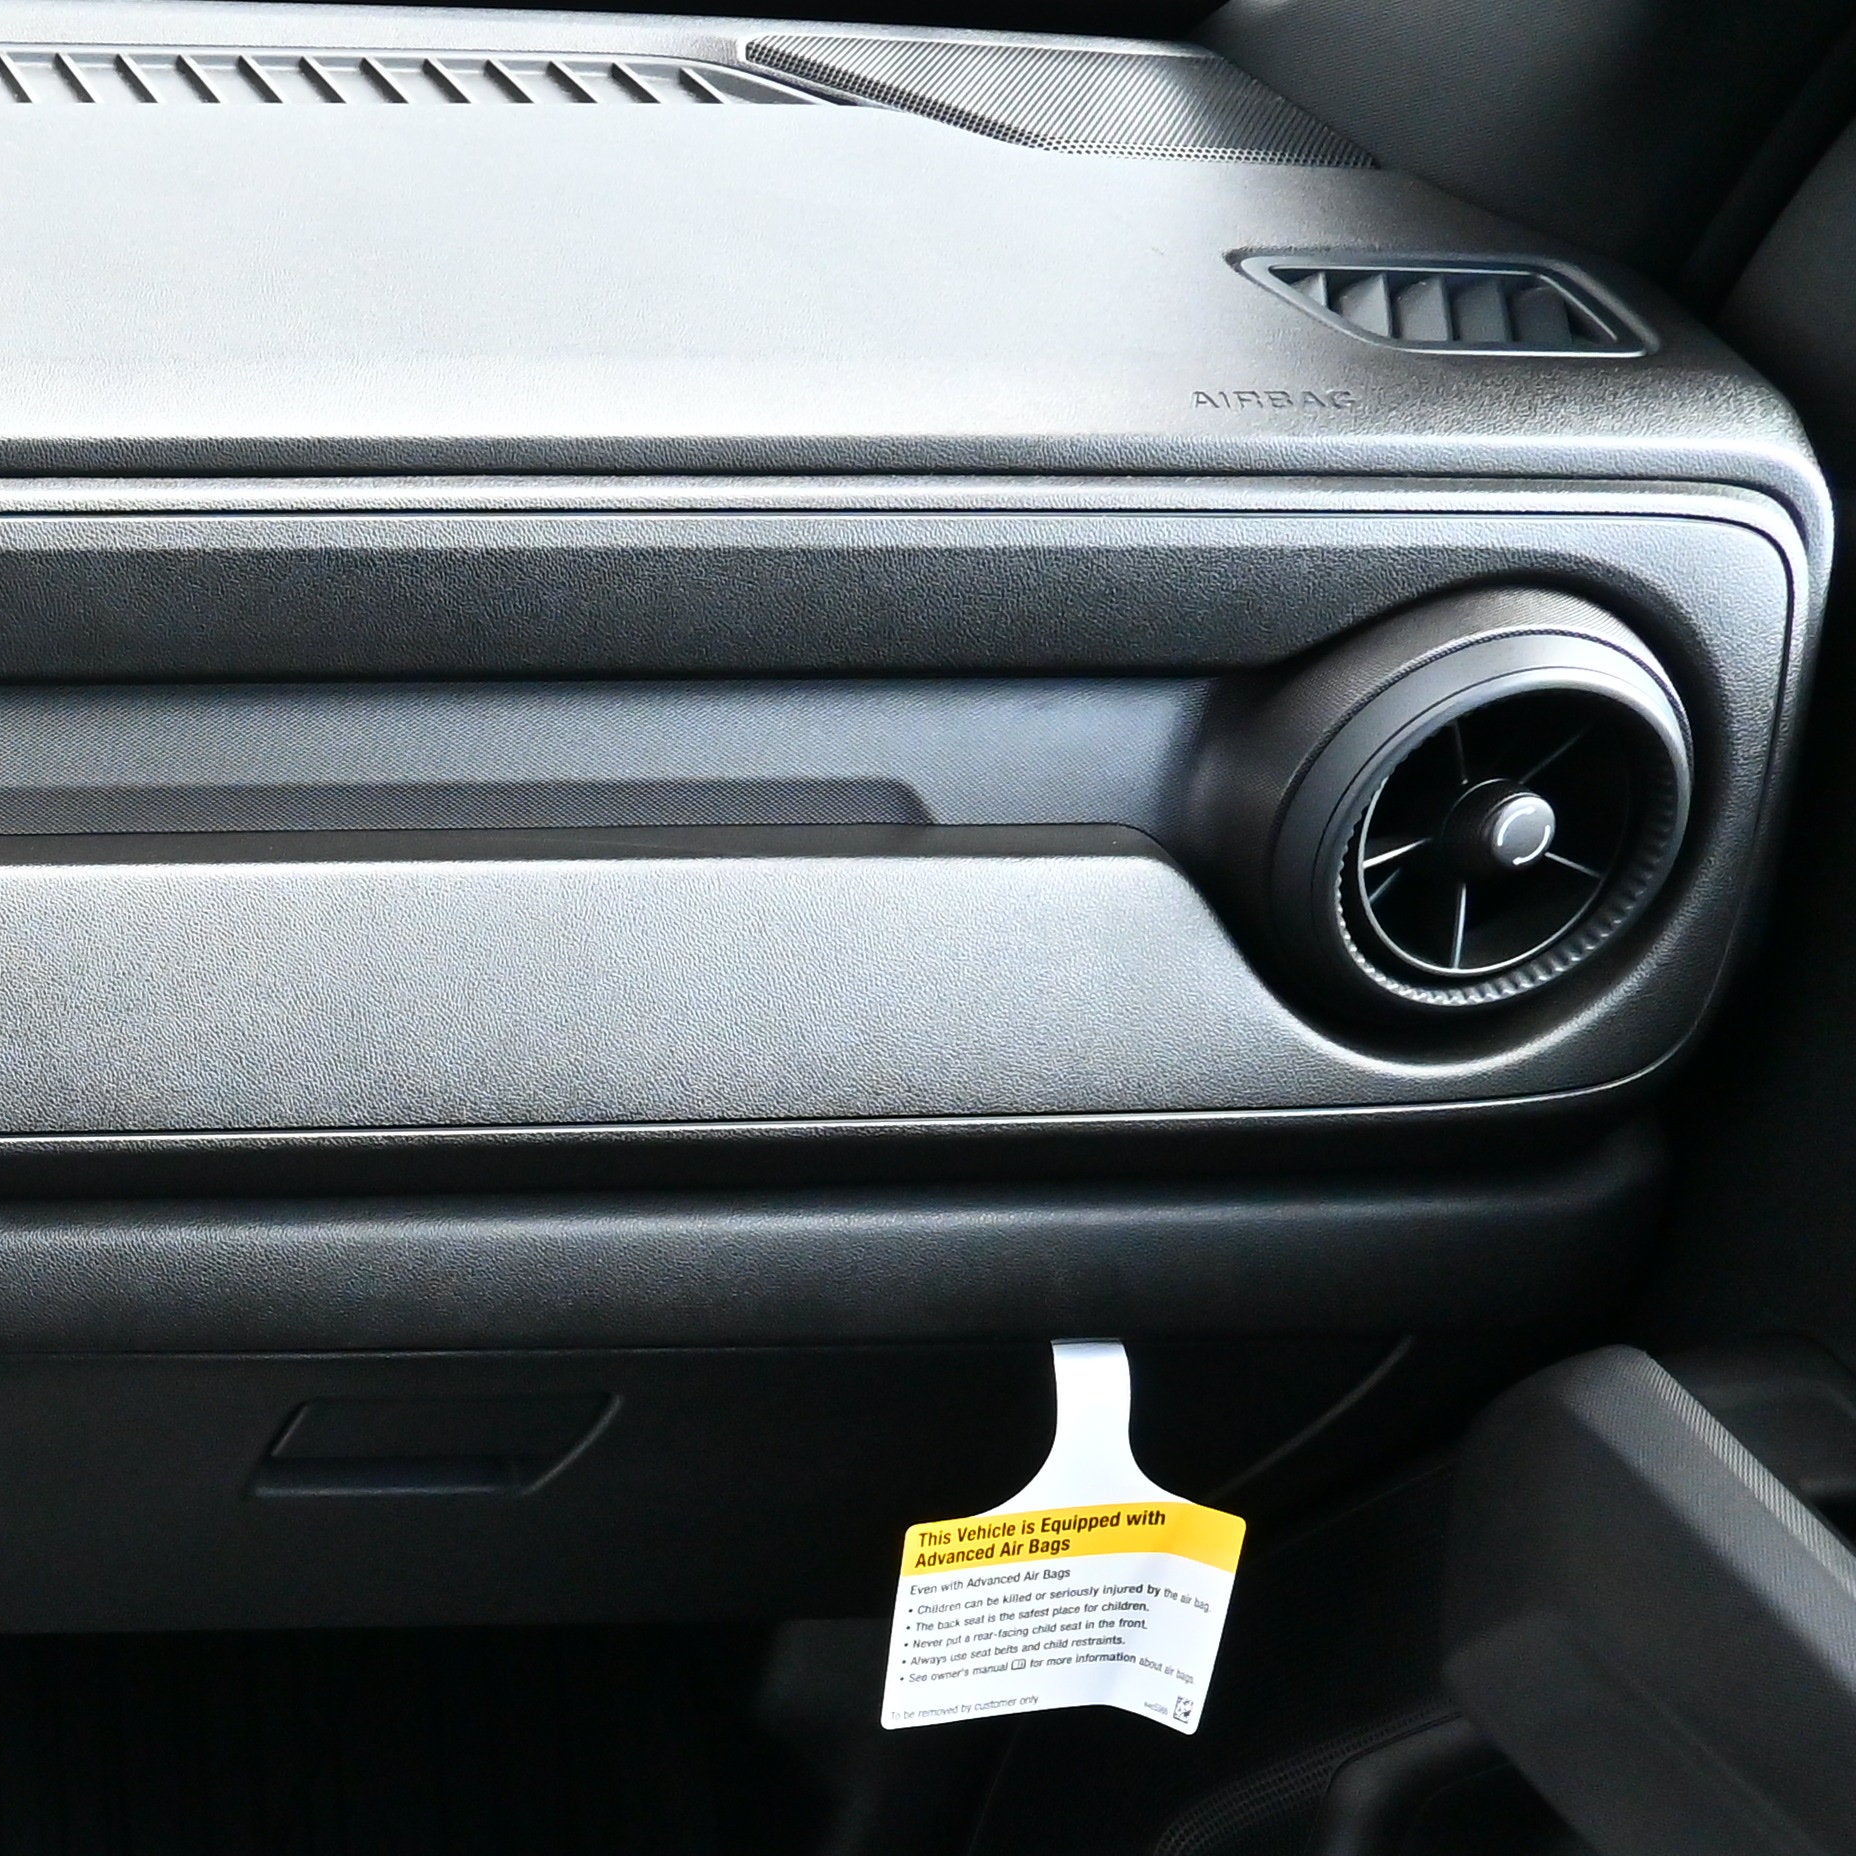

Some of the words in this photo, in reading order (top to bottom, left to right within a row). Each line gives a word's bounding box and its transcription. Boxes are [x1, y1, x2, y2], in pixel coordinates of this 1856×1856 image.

[1191, 390, 1358, 410] AIRBAG
[919, 1530, 951, 1548] This
[958, 1522, 1016, 1543] Vehicle
[1021, 1520, 1035, 1535] is
[1041, 1511, 1121, 1535] Equipped
[1126, 1510, 1166, 1526] with
[914, 1543, 996, 1569] Advanced
[999, 1540, 1024, 1558] Air
[1029, 1538, 1071, 1556] Bags
[910, 1584, 937, 1595] Even
[941, 1580, 964, 1592] with
[967, 1573, 1021, 1588] Advanced
[1023, 1571, 1039, 1582] Air
[1043, 1568, 1071, 1581] Bags
[917, 1602, 961, 1615] Children
[964, 1600, 983, 1609] can
[987, 1597, 1000, 1606] be
[1003, 1592, 1032, 1604] killed
[1035, 1592, 1047, 1601] or
[1050, 1586, 1100, 1600] seriously
[1102, 1584, 1143, 1597] injured
[1147, 1584, 1161, 1598] by
[1163, 1588, 1178, 1601] the
